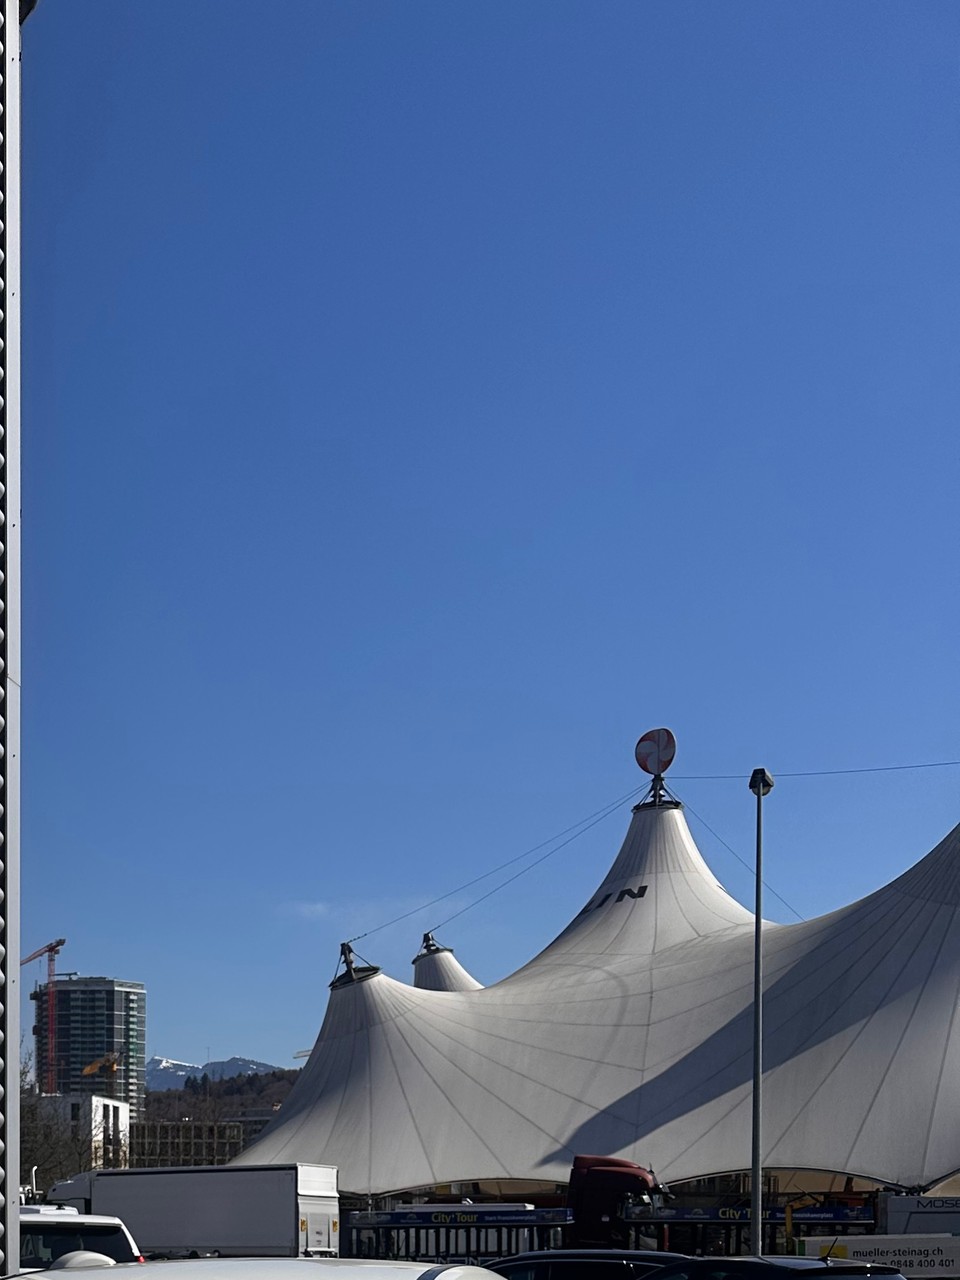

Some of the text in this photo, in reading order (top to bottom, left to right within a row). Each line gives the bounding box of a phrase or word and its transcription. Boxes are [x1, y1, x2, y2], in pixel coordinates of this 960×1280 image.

[431, 1212, 478, 1223] City Tour
[719, 1208, 771, 1219] City Tur
[852, 1247, 943, 1258] mueller-steinag.ch
[890, 1259, 914, 1268] 0848
[917, 1259, 936, 1268] 400
[938, 1259, 955, 1268] 401
